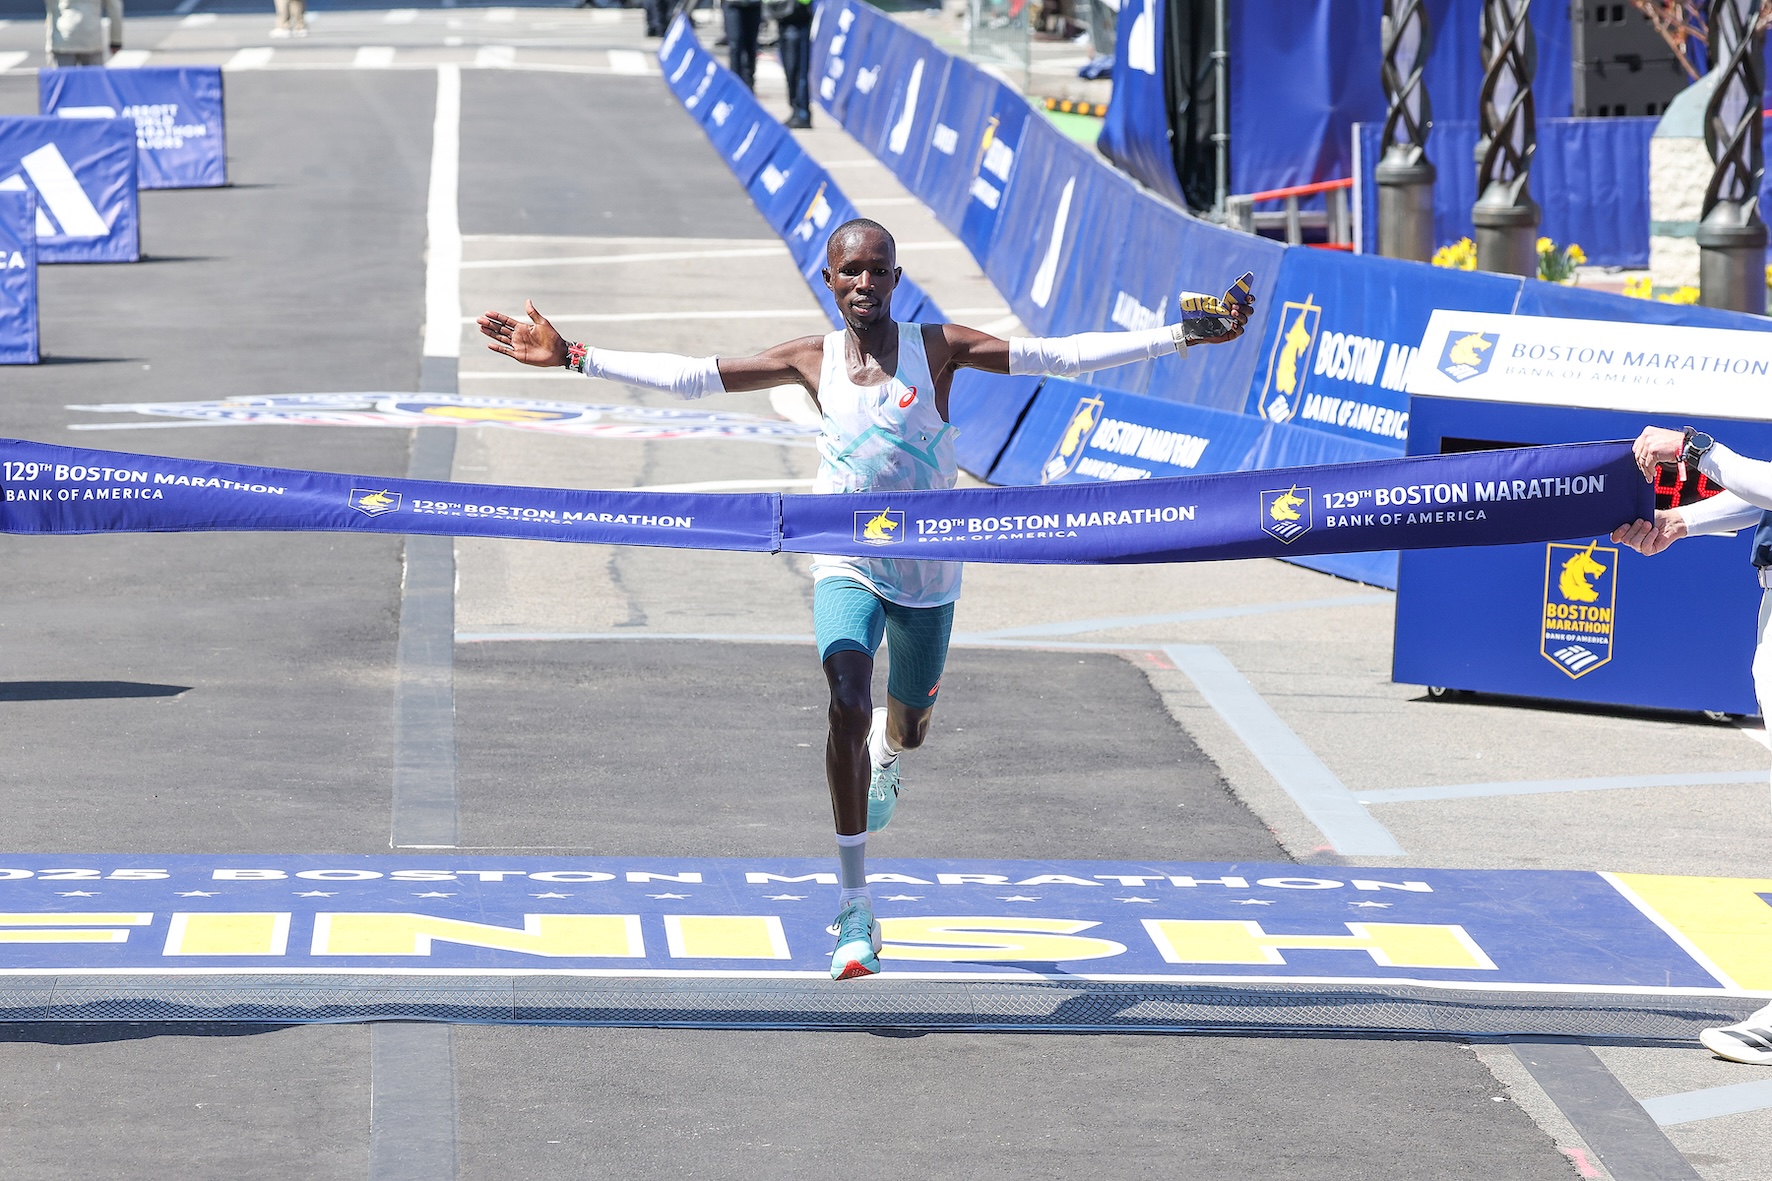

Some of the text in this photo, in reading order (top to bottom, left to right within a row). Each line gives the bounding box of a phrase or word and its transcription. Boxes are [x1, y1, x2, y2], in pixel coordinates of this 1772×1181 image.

[134, 115, 175, 128] ORLD
[136, 124, 206, 138] ARATHON
[137, 137, 183, 150] AJORS
[1314, 330, 1385, 386] BOSTON
[1511, 343, 1769, 376] BOSTON MARATHON
[1505, 366, 1676, 386] BANK OF AMERICA
[1301, 393, 1341, 425] BANK
[1347, 402, 1410, 441] AMERIC
[1090, 417, 1146, 456] BOSTON
[3, 461, 285, 495] 129TH BOSTON MARATHON
[6, 487, 163, 502] BANK OF AMERICA
[1323, 474, 1605, 509] 129TH BOSTON MARATHON
[412, 499, 691, 528] 129TH BOSTON MARATHON
[413, 508, 461, 516] BANK
[492, 515, 573, 525] AMERICA
[916, 505, 1196, 535] 129TH BOSTON MARATHON
[1326, 509, 1487, 528] BANK OF AMERICA
[918, 535, 966, 543] BANK
[997, 530, 1078, 540] AMERICA
[1547, 603, 1611, 622] BOSTON
[1546, 618, 1610, 635] MARATHON
[1545, 632, 1565, 640] BANK
[1576, 635, 1609, 645] AMERICA
[0, 868, 1434, 893] 025 BOSTON MARATHON
